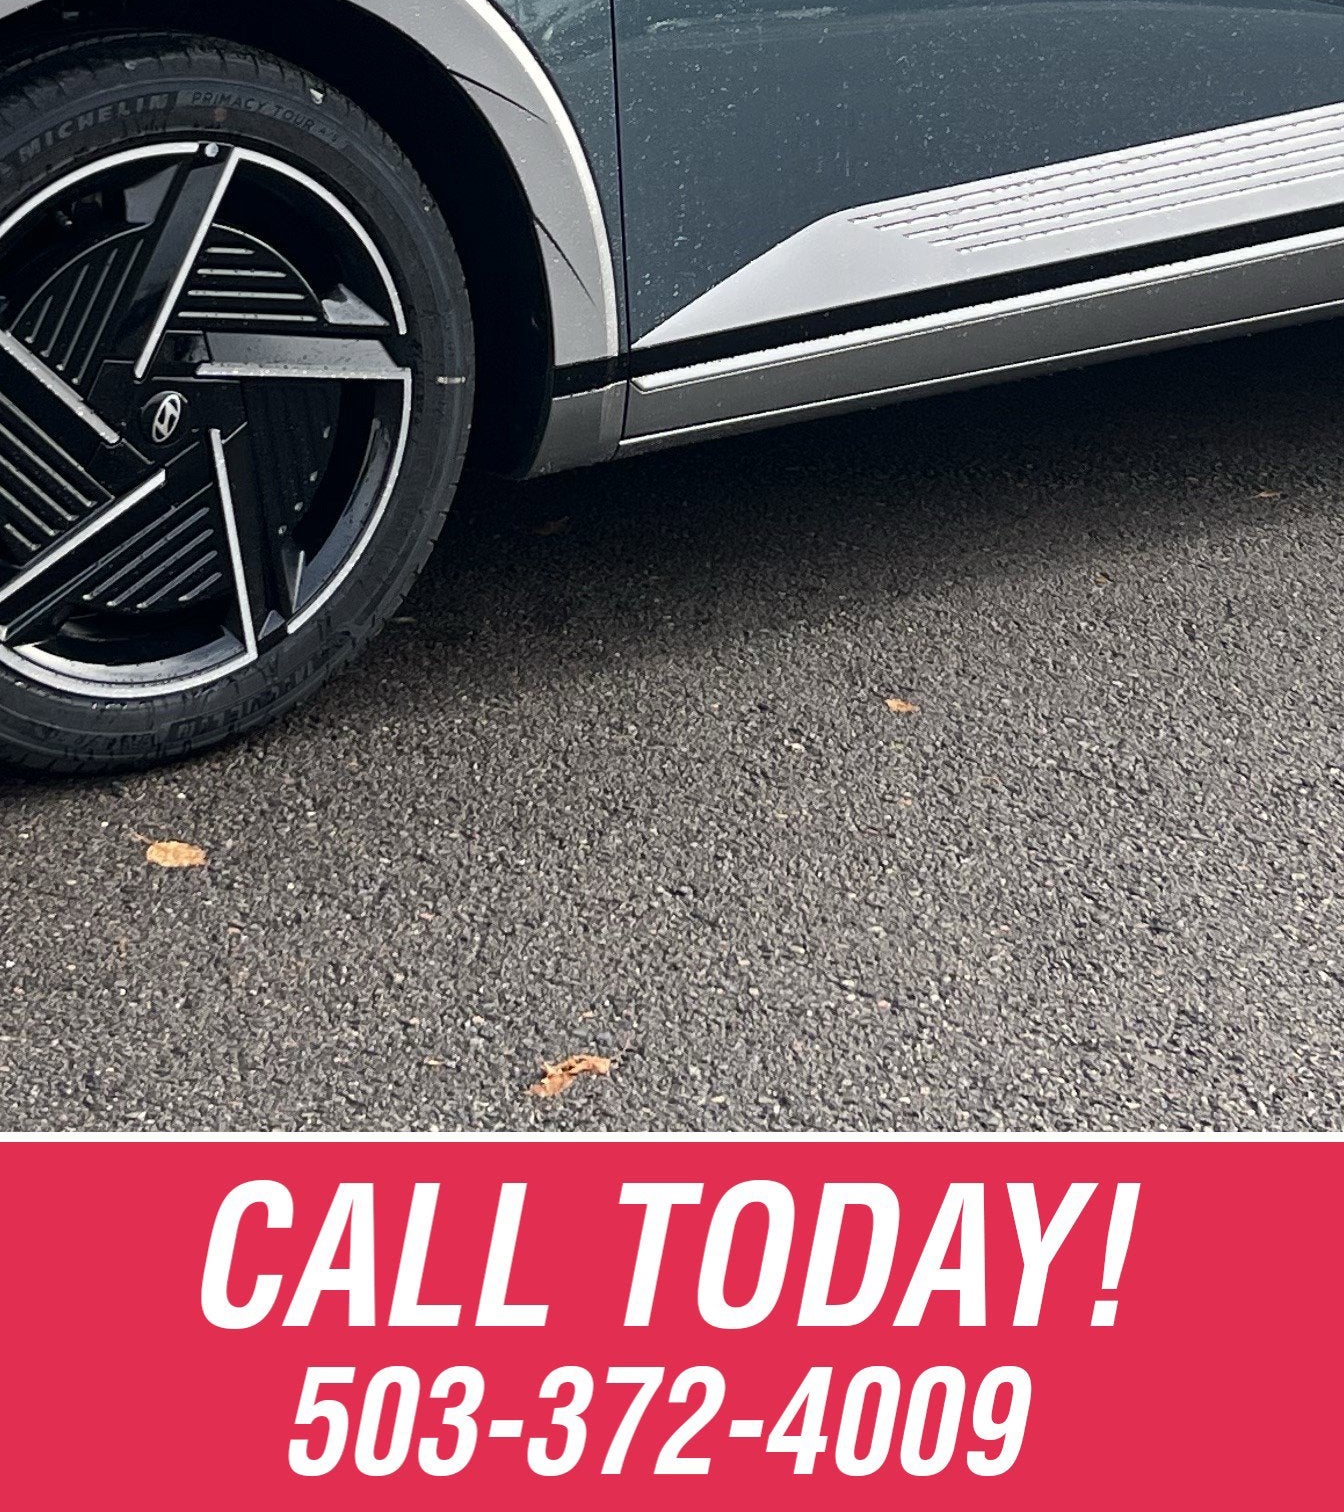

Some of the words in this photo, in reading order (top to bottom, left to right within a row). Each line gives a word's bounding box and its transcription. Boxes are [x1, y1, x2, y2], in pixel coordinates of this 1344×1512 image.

[18, 93, 171, 164] MICHELIN
[191, 91, 269, 112] PRIMACY
[274, 104, 315, 132] TOUR
